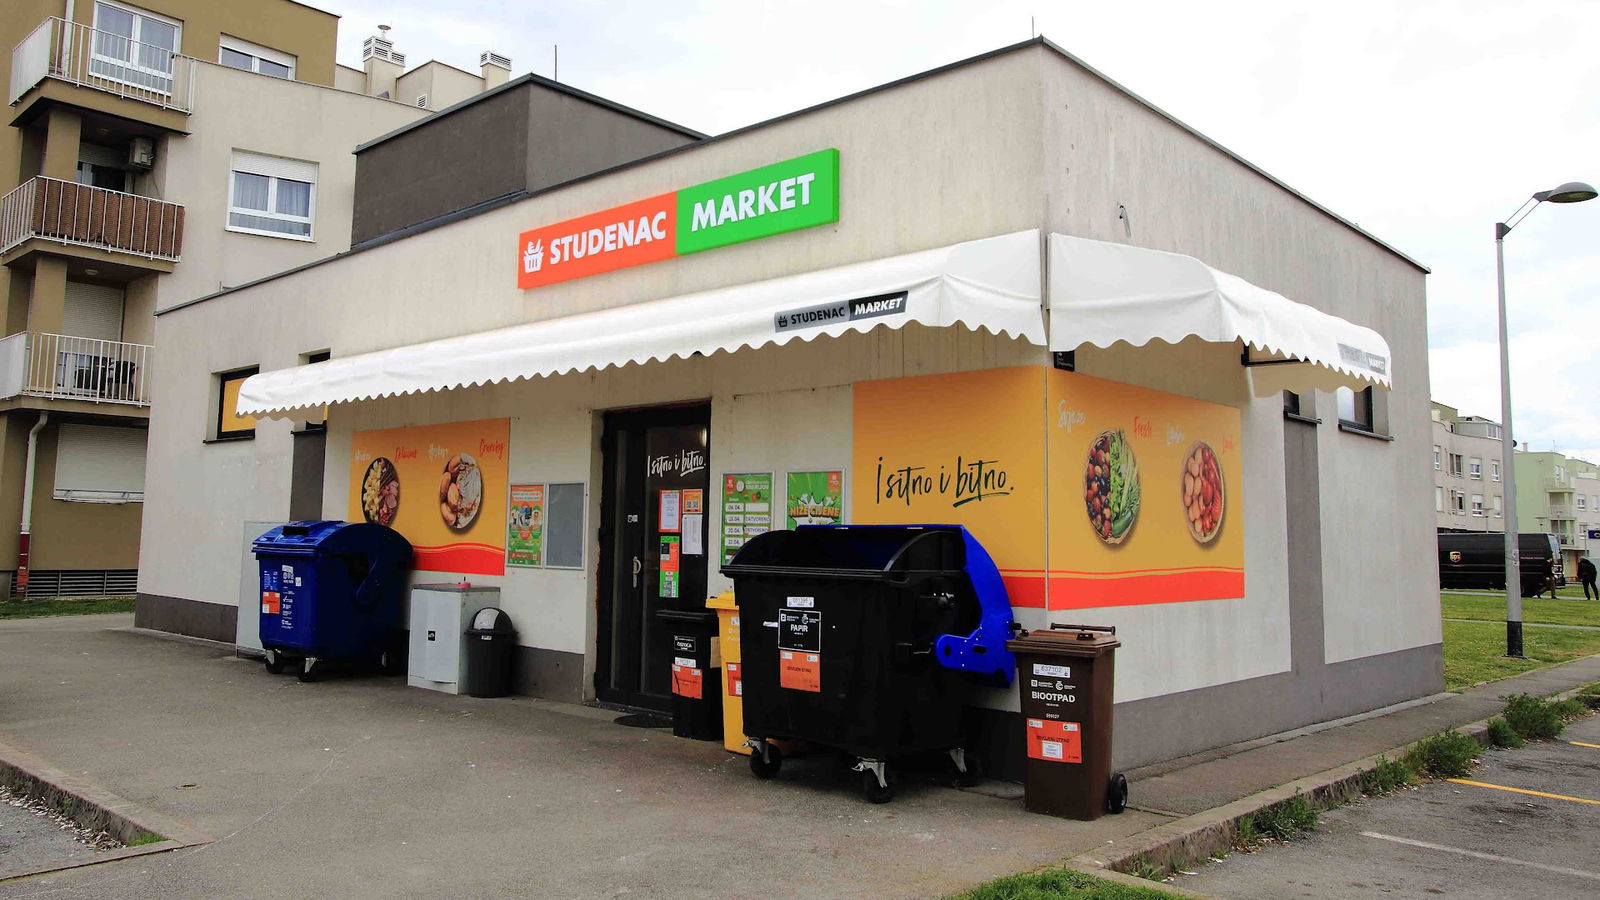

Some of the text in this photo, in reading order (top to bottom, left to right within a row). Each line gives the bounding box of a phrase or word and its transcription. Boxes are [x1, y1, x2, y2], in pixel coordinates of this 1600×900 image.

[550, 172, 815, 265] STUDENAC MARKET
[790, 298, 903, 325] STUDENAC MARKET
[651, 456, 672, 478] sitno
[674, 454, 681, 472] i
[885, 466, 933, 506] sitno
[939, 465, 951, 494] i
[810, 506, 839, 518] CIJENE
[790, 624, 808, 633] PAPIR
[1031, 690, 1076, 703] BIOOTPAD
